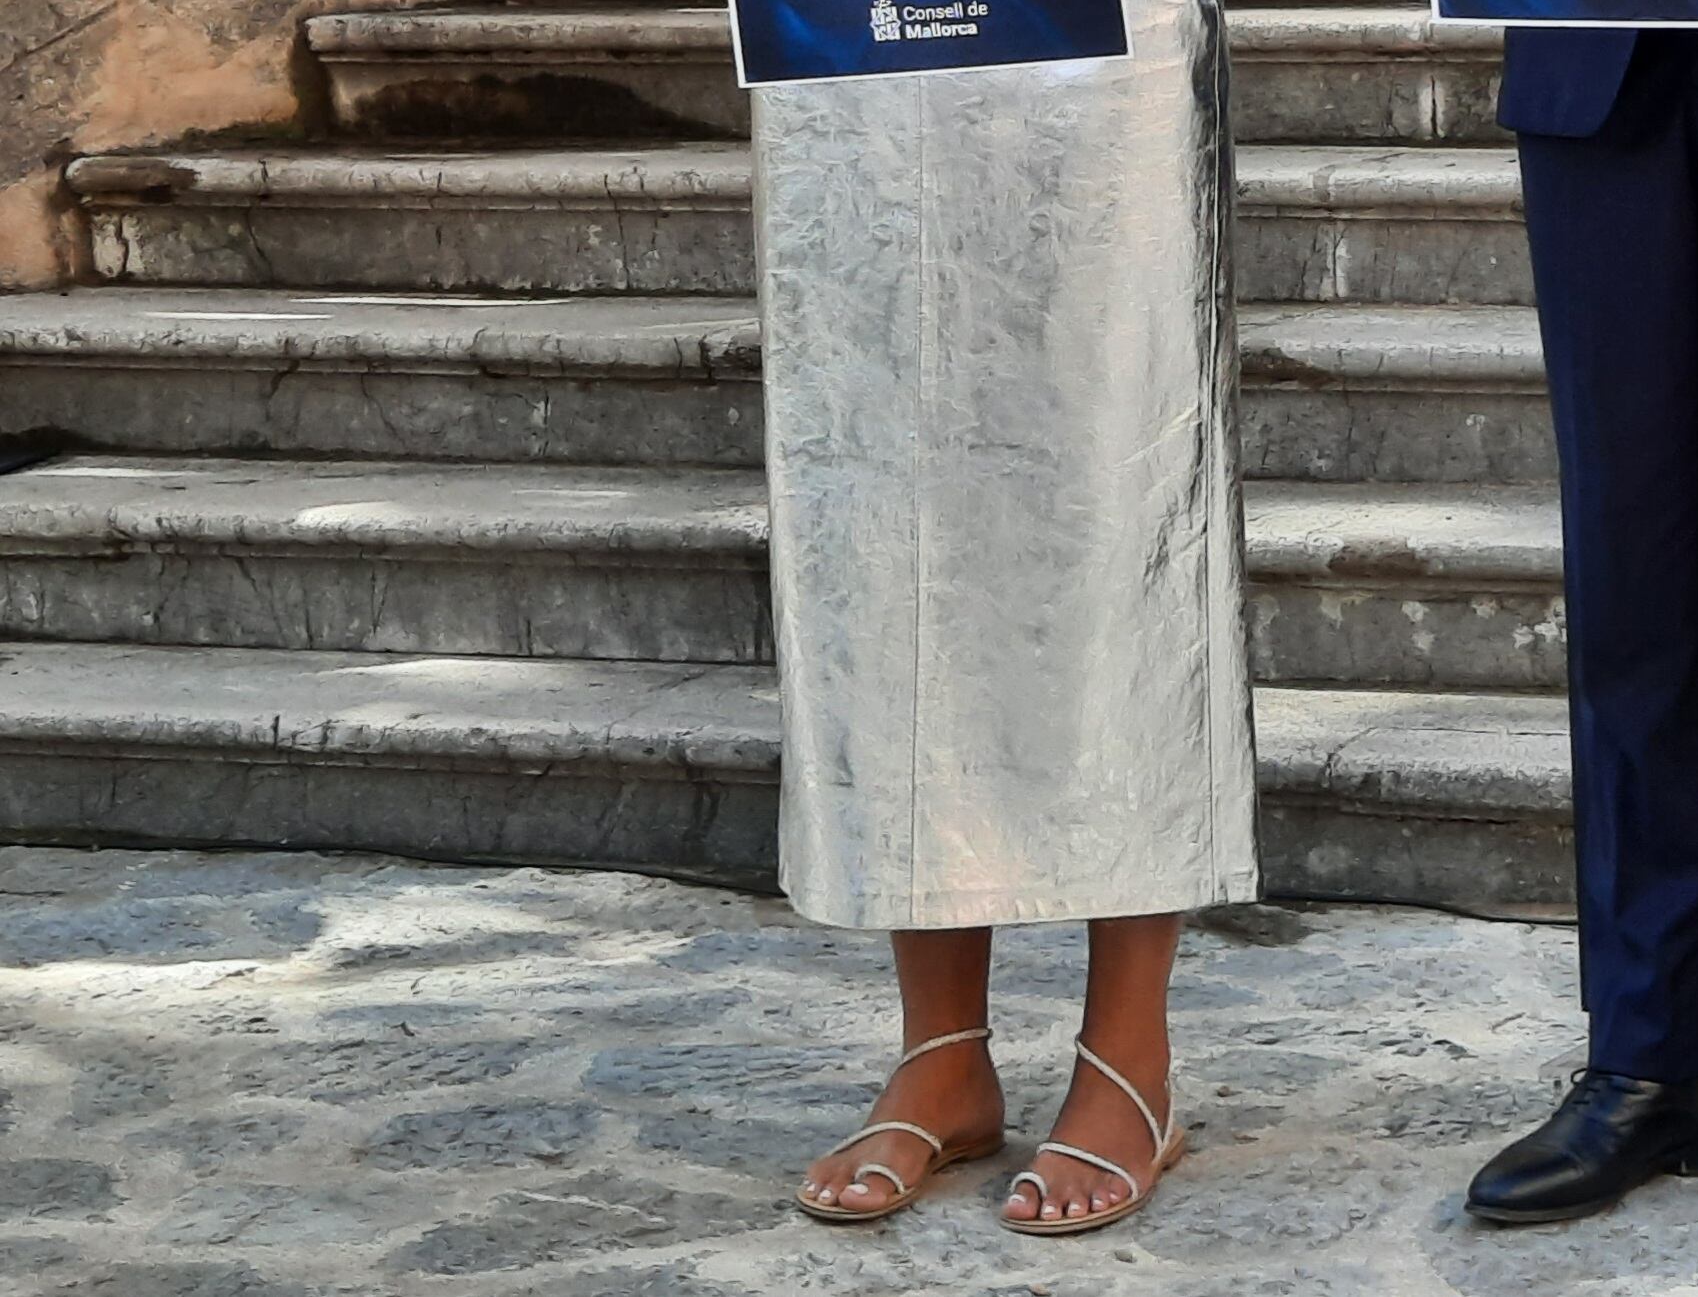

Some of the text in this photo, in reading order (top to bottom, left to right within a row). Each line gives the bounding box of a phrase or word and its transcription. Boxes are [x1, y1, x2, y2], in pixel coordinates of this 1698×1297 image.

[903, 1, 988, 21] Consell de
[905, 22, 978, 39] Mallorca
